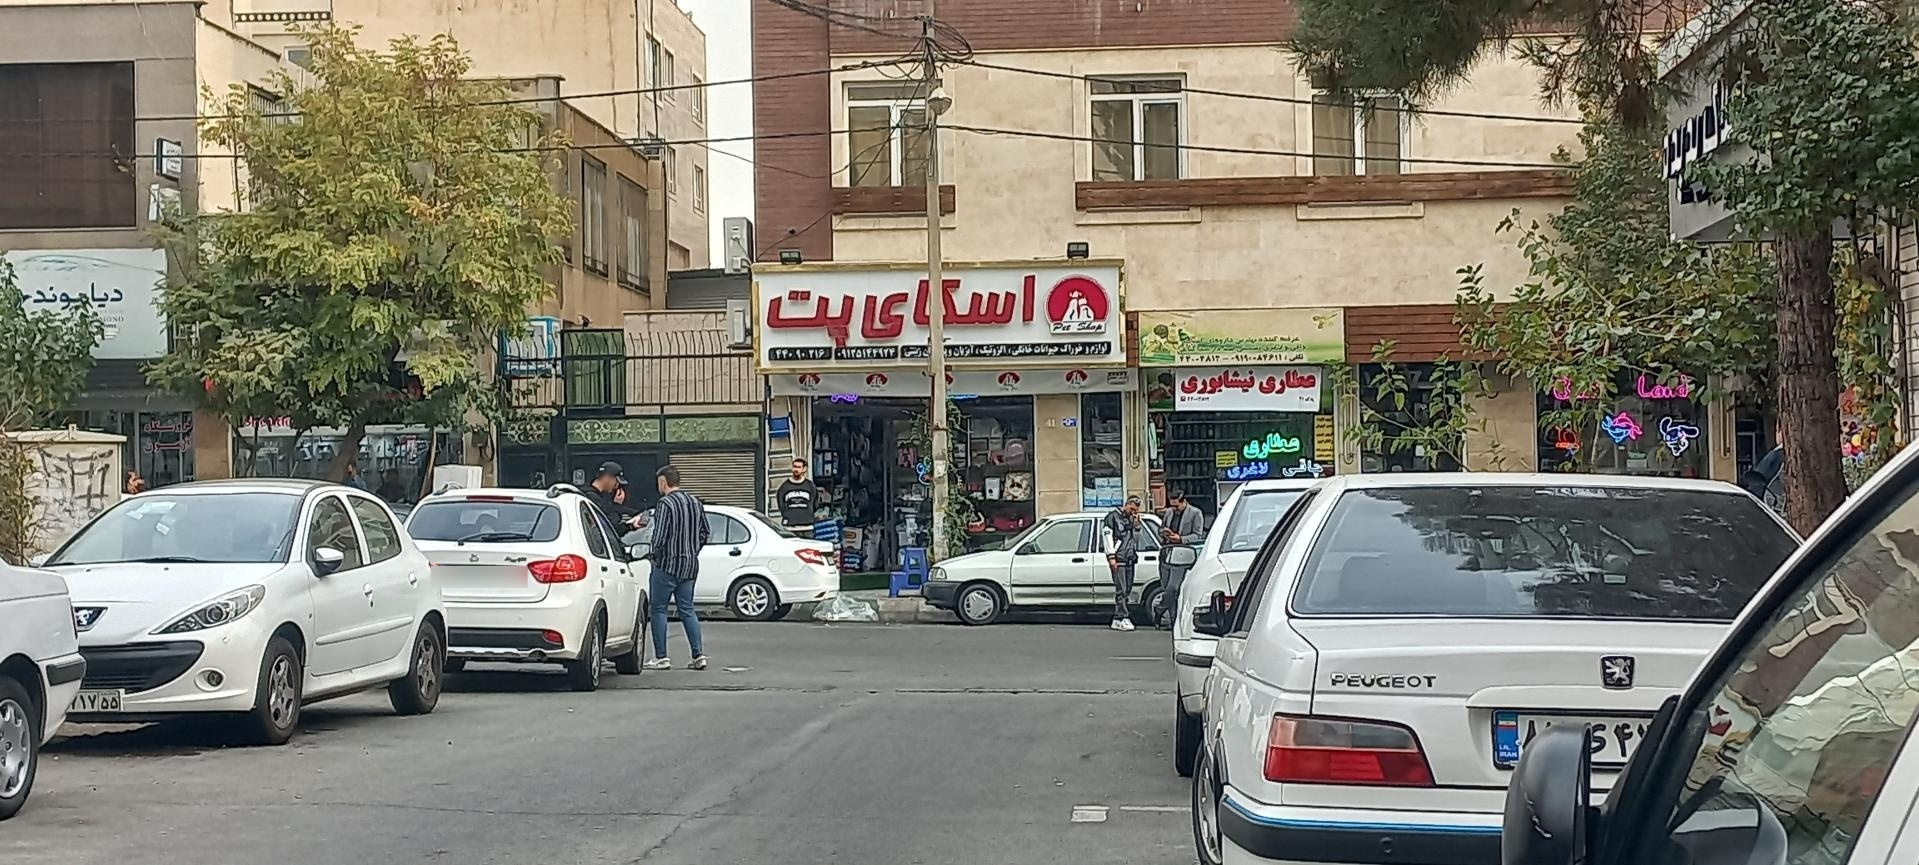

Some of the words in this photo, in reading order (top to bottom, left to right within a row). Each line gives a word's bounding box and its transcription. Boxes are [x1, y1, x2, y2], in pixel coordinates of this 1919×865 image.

[33, 282, 123, 311] دیاوند
[860, 273, 1036, 339] اسکای
[766, 290, 855, 349] پت
[1053, 323, 1071, 331] Pet
[1077, 322, 1103, 332] Shop
[1090, 343, 1108, 353] لوازم
[1180, 370, 1255, 394] نیشابوری
[1258, 369, 1316, 394] عطاری
[1243, 433, 1300, 459] عطاری
[1227, 462, 1269, 479] لاغری
[1331, 673, 1437, 689] PEUGEOT
